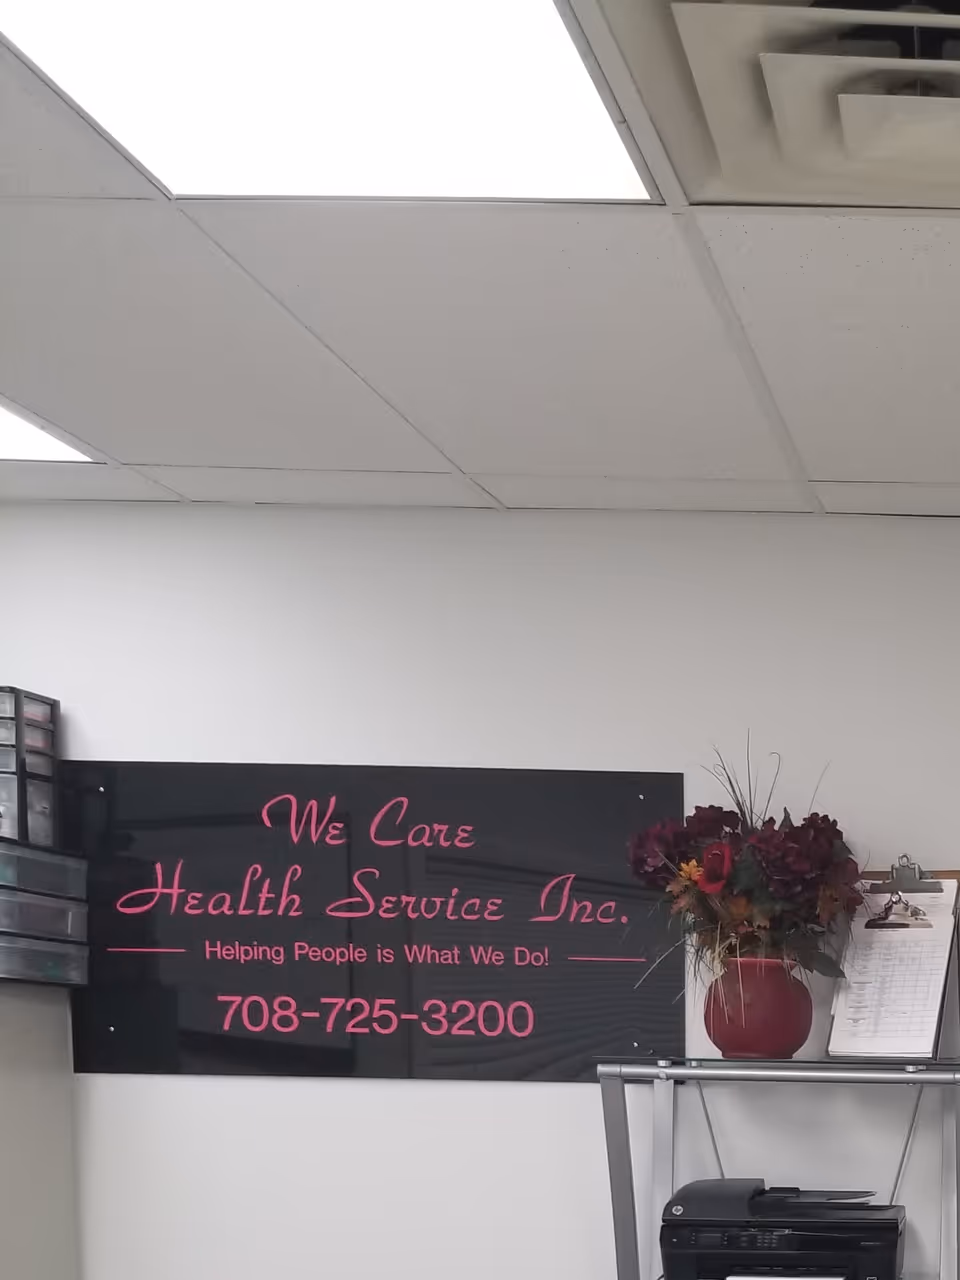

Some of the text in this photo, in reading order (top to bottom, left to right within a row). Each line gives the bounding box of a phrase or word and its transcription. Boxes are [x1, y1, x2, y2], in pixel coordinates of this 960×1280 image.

[261, 793, 475, 849] We Care
[116, 859, 629, 925] Health Service Inc.
[205, 940, 550, 968] Helping People is What We Do!
[217, 995, 535, 1038] 708-725-3200
